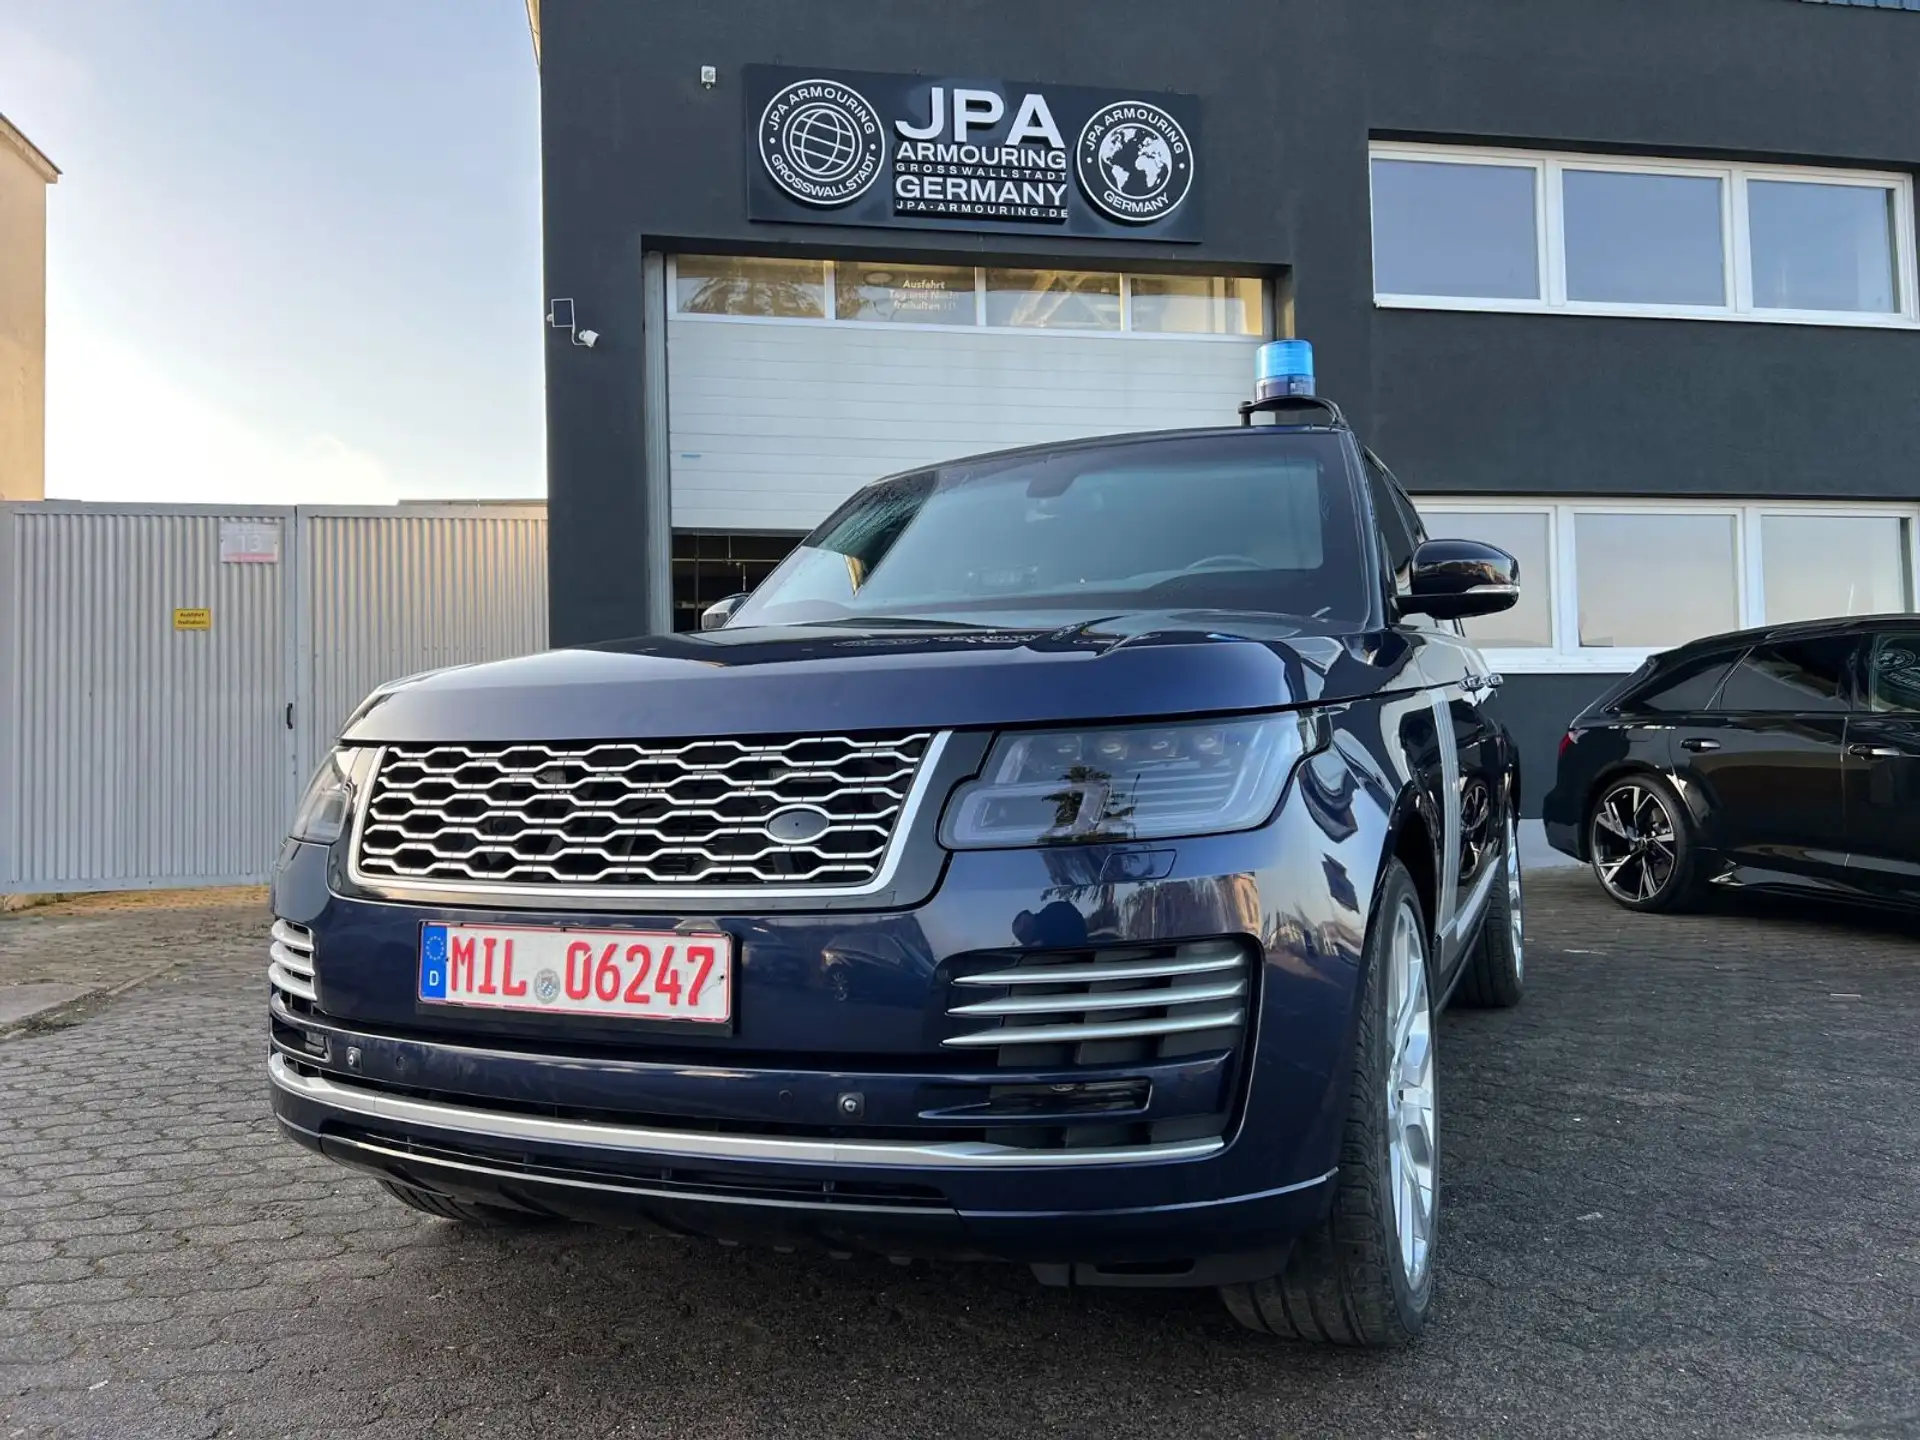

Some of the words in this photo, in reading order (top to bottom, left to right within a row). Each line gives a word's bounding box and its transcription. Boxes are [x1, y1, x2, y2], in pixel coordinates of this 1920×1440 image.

[768, 104, 789, 131] JPA
[789, 86, 876, 134] ARMOURING
[895, 86, 1066, 149] JPA
[1086, 124, 1105, 151] JPA
[1104, 108, 1185, 154] ARMOURING
[896, 141, 1067, 169] ARMOURING
[771, 152, 876, 197] GROSSWALLSTADT
[896, 162, 1067, 181] GROSSWALLSTADT
[895, 174, 1067, 206] GERMANY
[1103, 190, 1169, 213] GERMANY
[896, 200, 1068, 218] JPA-ARMOURING.DE
[902, 280, 945, 290] Ausfahrt
[931, 290, 959, 300] Nht
[236, 533, 262, 553] 13
[429, 970, 439, 986] D
[451, 936, 527, 997] MIL
[565, 941, 715, 1007] 06247
